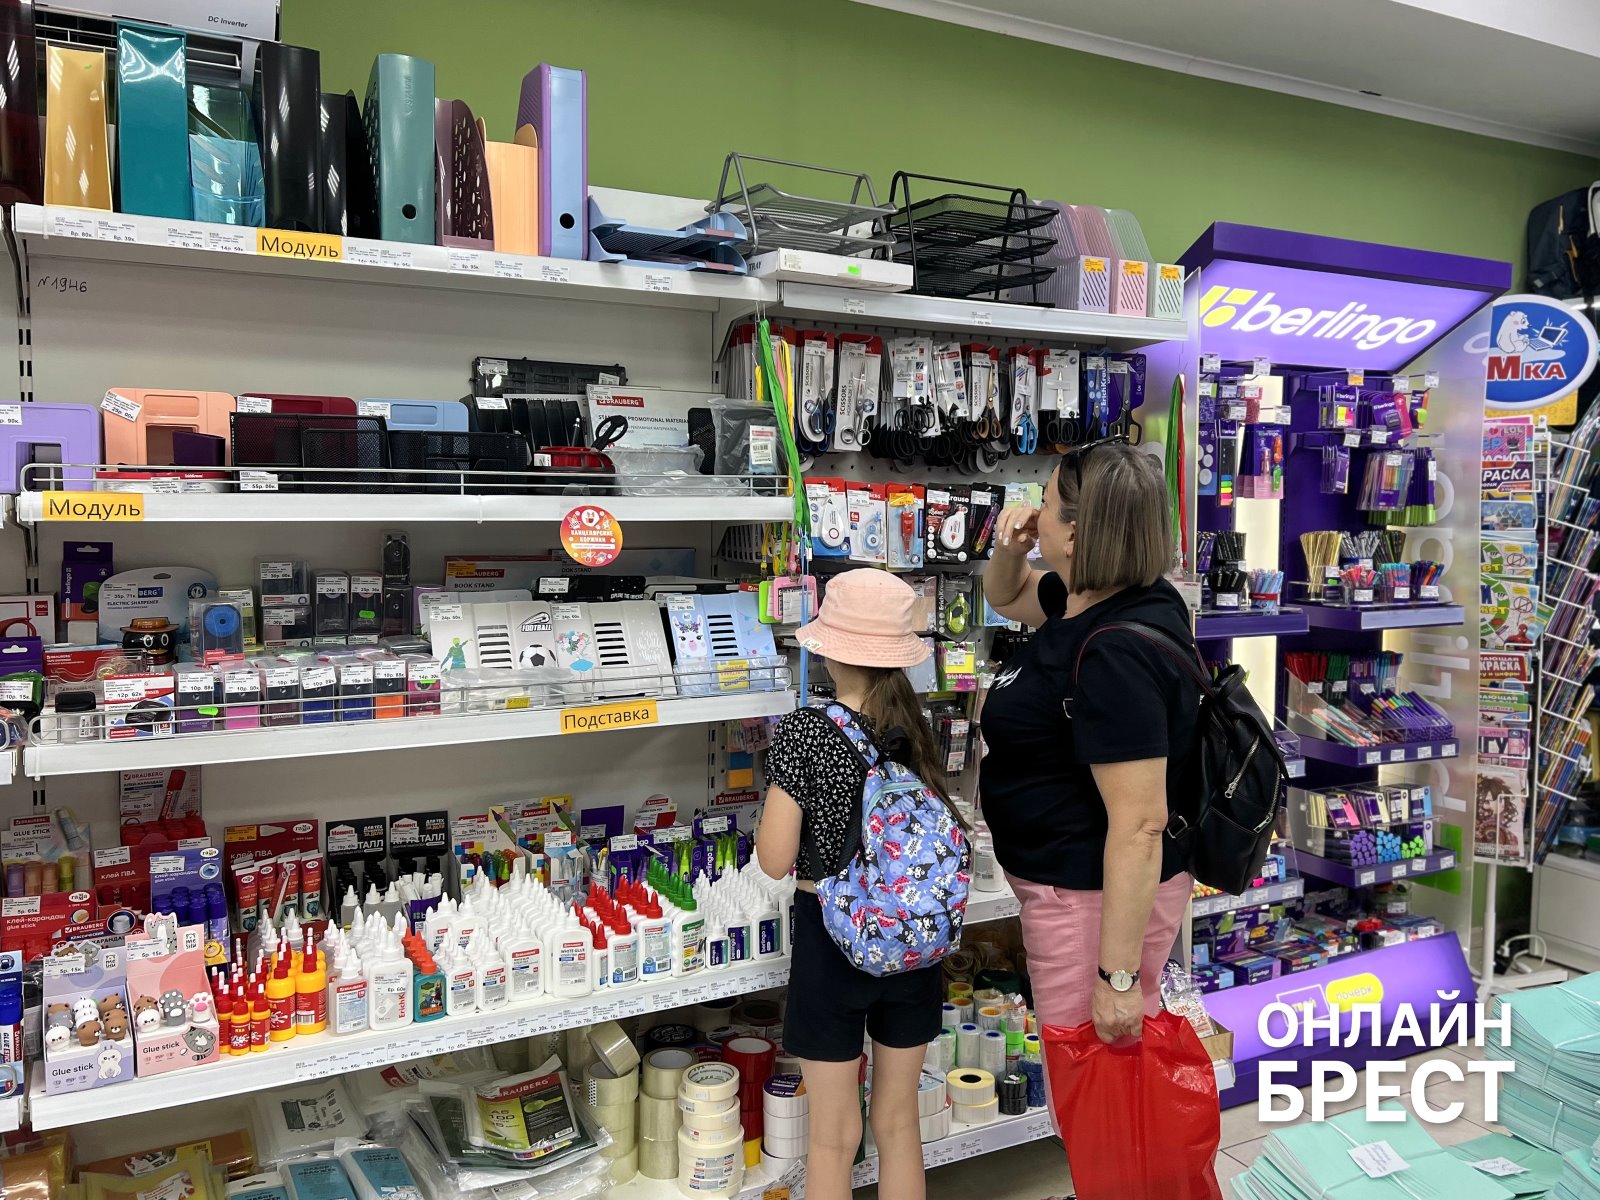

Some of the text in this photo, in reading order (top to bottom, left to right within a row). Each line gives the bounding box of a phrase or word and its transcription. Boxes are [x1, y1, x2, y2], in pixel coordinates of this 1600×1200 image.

[208, 15, 248, 28] DC Inverter
[260, 234, 339, 258] Модуль
[1231, 292, 1437, 350] berlingo
[840, 384, 848, 416] SCISSORS
[1482, 468, 1530, 482] РАСКА
[49, 498, 141, 520] Модуль
[521, 623, 552, 632] FOOTBALL
[564, 707, 650, 730] Подставка
[724, 794, 755, 802] BRAUBERG
[357, 839, 384, 849] ТАЛЛ
[6, 914, 66, 924] клей-карандаш
[72, 922, 104, 932] BRAUBERG
[1335, 985, 1373, 1000] почерк
[142, 1040, 180, 1054] Glue stick
[51, 1062, 94, 1077] Glue stick
